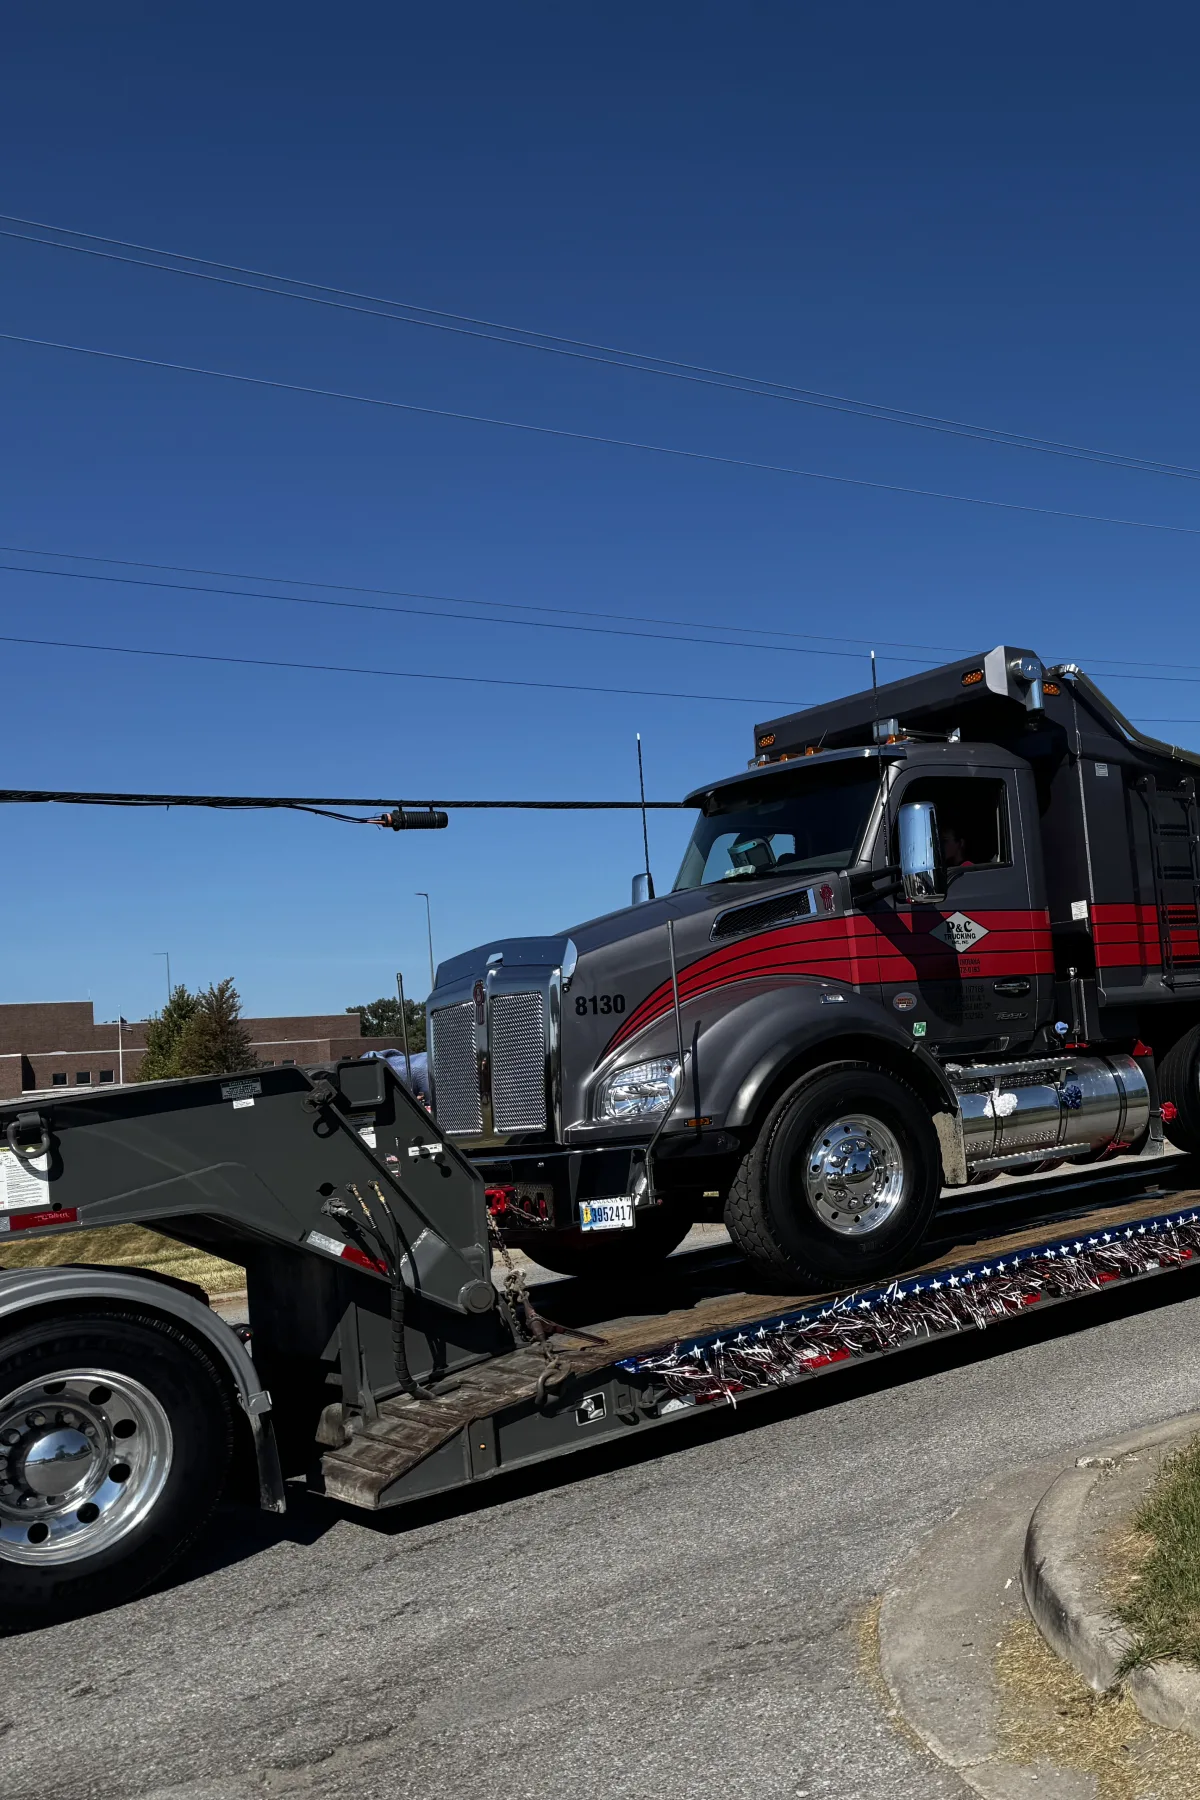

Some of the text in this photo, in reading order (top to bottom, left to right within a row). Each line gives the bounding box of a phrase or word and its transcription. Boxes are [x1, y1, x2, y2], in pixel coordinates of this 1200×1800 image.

[946, 920, 973, 932] P&C
[944, 932, 976, 941] TRUCKING
[575, 994, 626, 1016] 8130
[592, 1204, 632, 1223] 3952417
